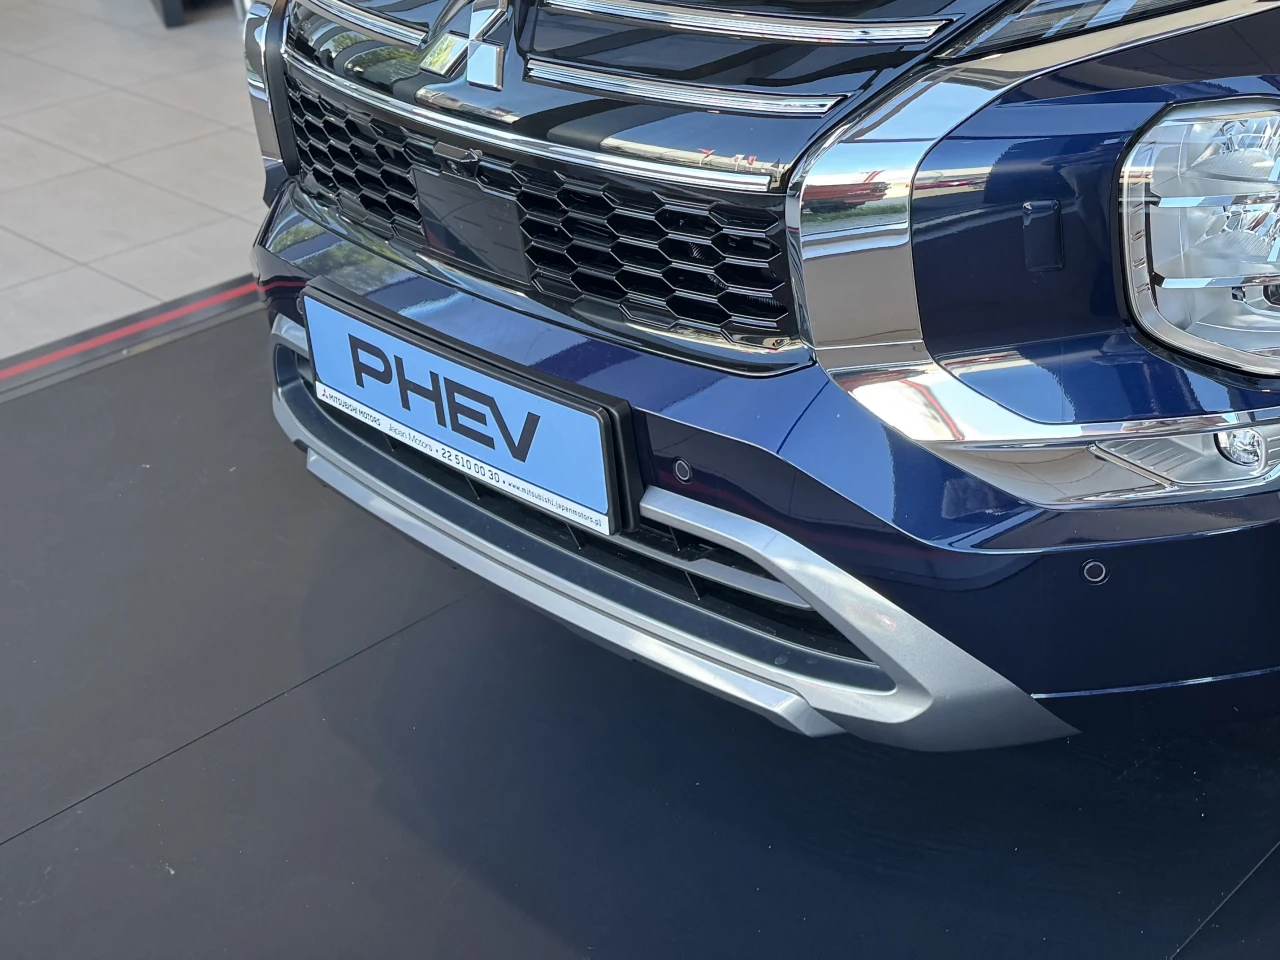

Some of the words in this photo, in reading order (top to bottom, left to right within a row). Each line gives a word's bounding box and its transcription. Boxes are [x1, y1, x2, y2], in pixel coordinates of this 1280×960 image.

[328, 393, 358, 414] MITSUBISHI
[358, 409, 382, 427] MOTORS
[347, 332, 541, 464] PHEV
[388, 423, 408, 440] Japan
[408, 432, 433, 452] Motors
[441, 447, 453, 462] 22
[455, 454, 472, 470] 510
[474, 463, 486, 477] 00
[488, 469, 500, 483] 30
